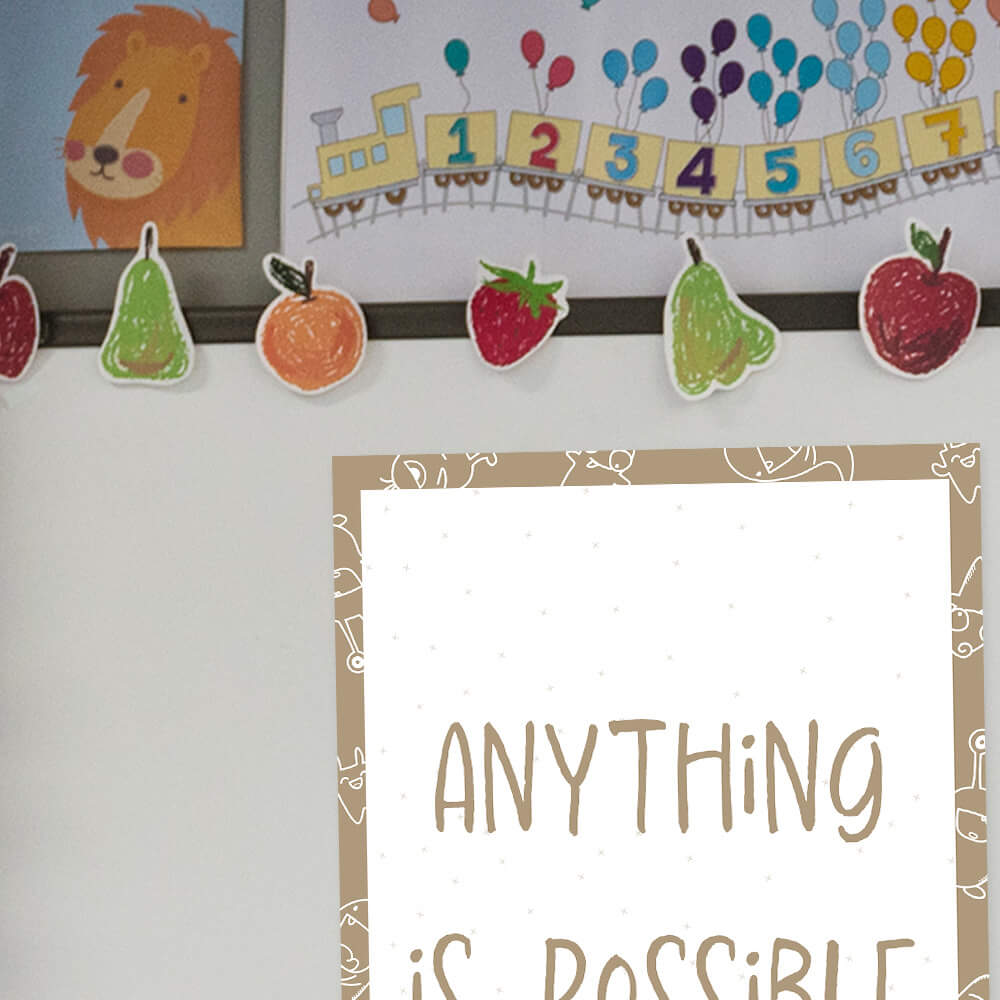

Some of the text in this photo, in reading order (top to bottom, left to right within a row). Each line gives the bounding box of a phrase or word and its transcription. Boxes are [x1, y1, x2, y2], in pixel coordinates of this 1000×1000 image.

[447, 116, 476, 164] 1
[528, 121, 560, 171] 2
[604, 132, 639, 182] 3
[675, 146, 718, 196] 4
[764, 146, 800, 195] 5
[843, 130, 880, 179] 6
[923, 107, 967, 158] 7
